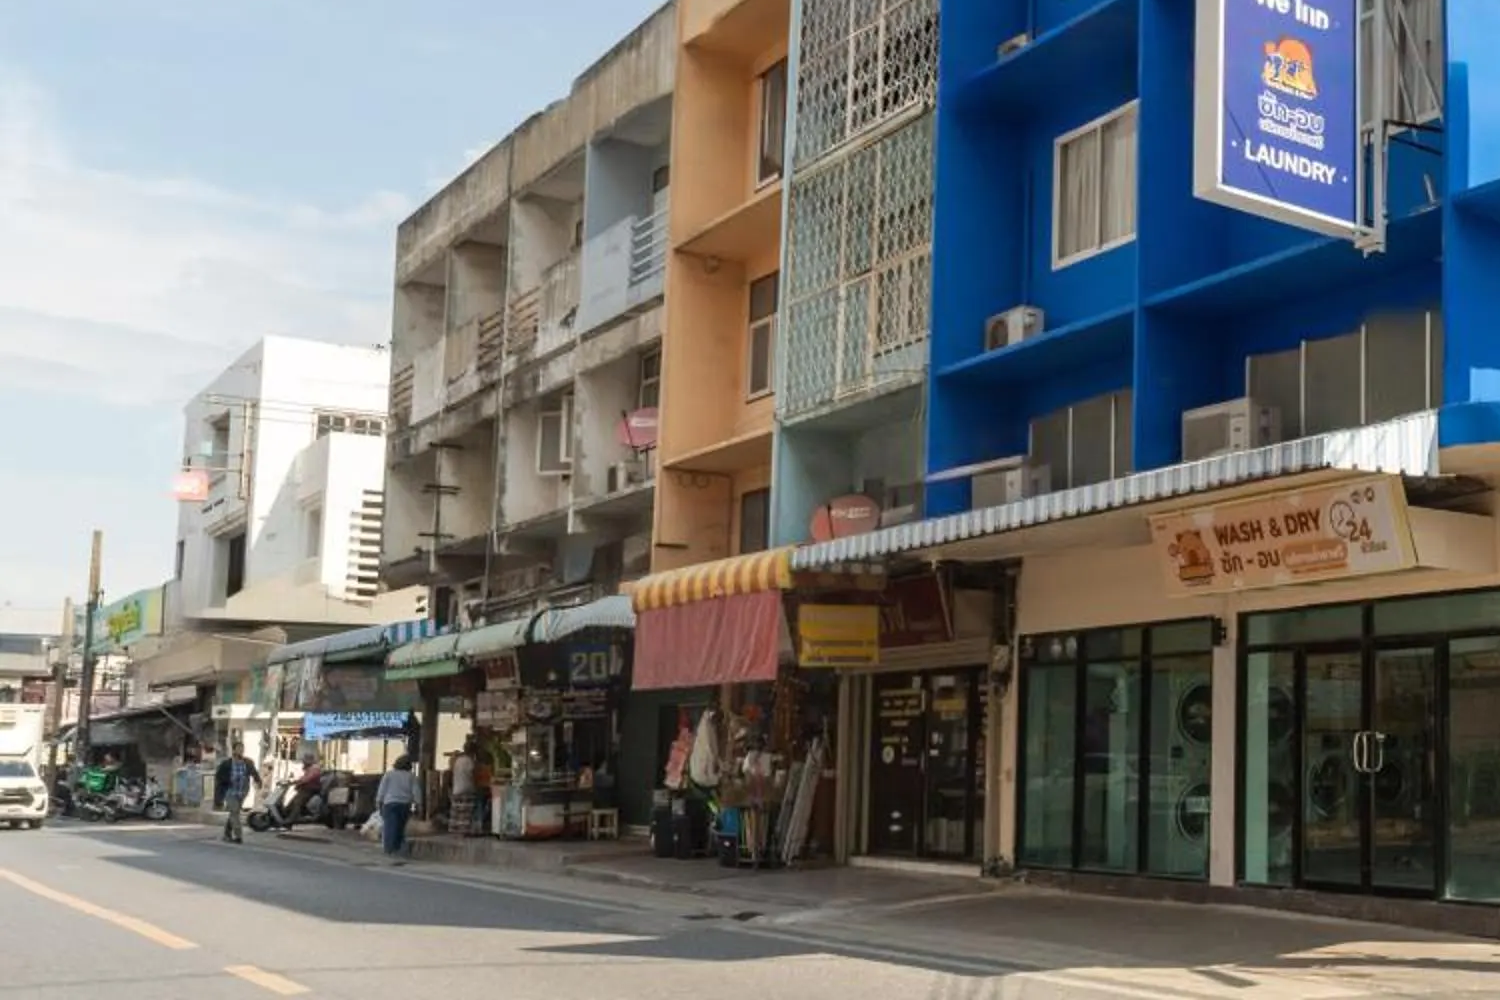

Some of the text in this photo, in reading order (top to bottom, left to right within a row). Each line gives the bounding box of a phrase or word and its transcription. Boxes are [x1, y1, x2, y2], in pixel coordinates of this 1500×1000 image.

[1244, 138, 1337, 185] LAUNDRY
[1213, 508, 1322, 547] WASH & DRY
[1345, 517, 1373, 543] 24
